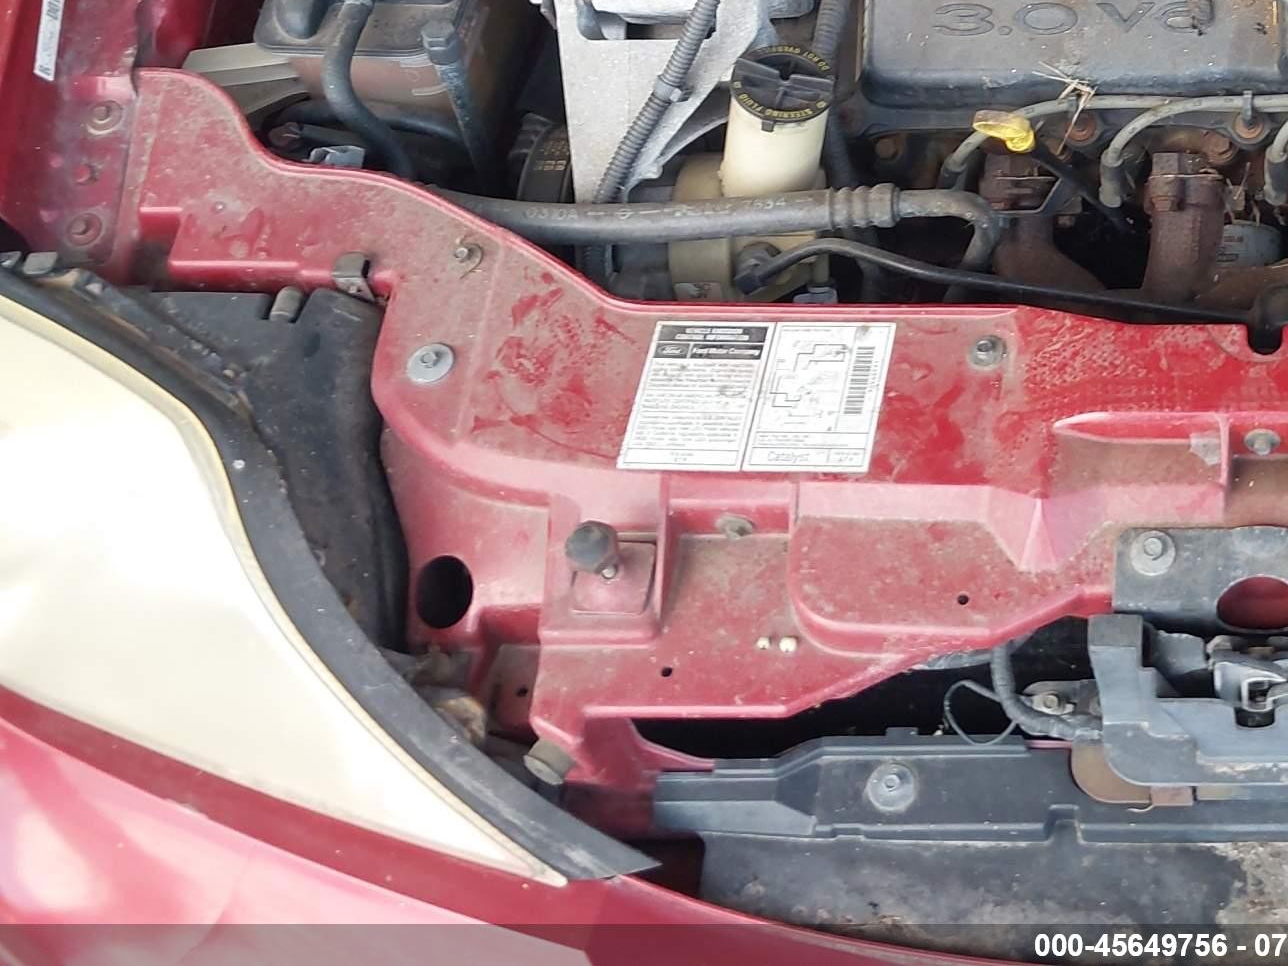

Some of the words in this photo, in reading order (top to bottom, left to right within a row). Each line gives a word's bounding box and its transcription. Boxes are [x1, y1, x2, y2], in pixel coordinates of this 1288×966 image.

[931, 2, 1078, 36] 3.0
[739, 93, 764, 113] FLUID
[764, 108, 813, 120] STEERING
